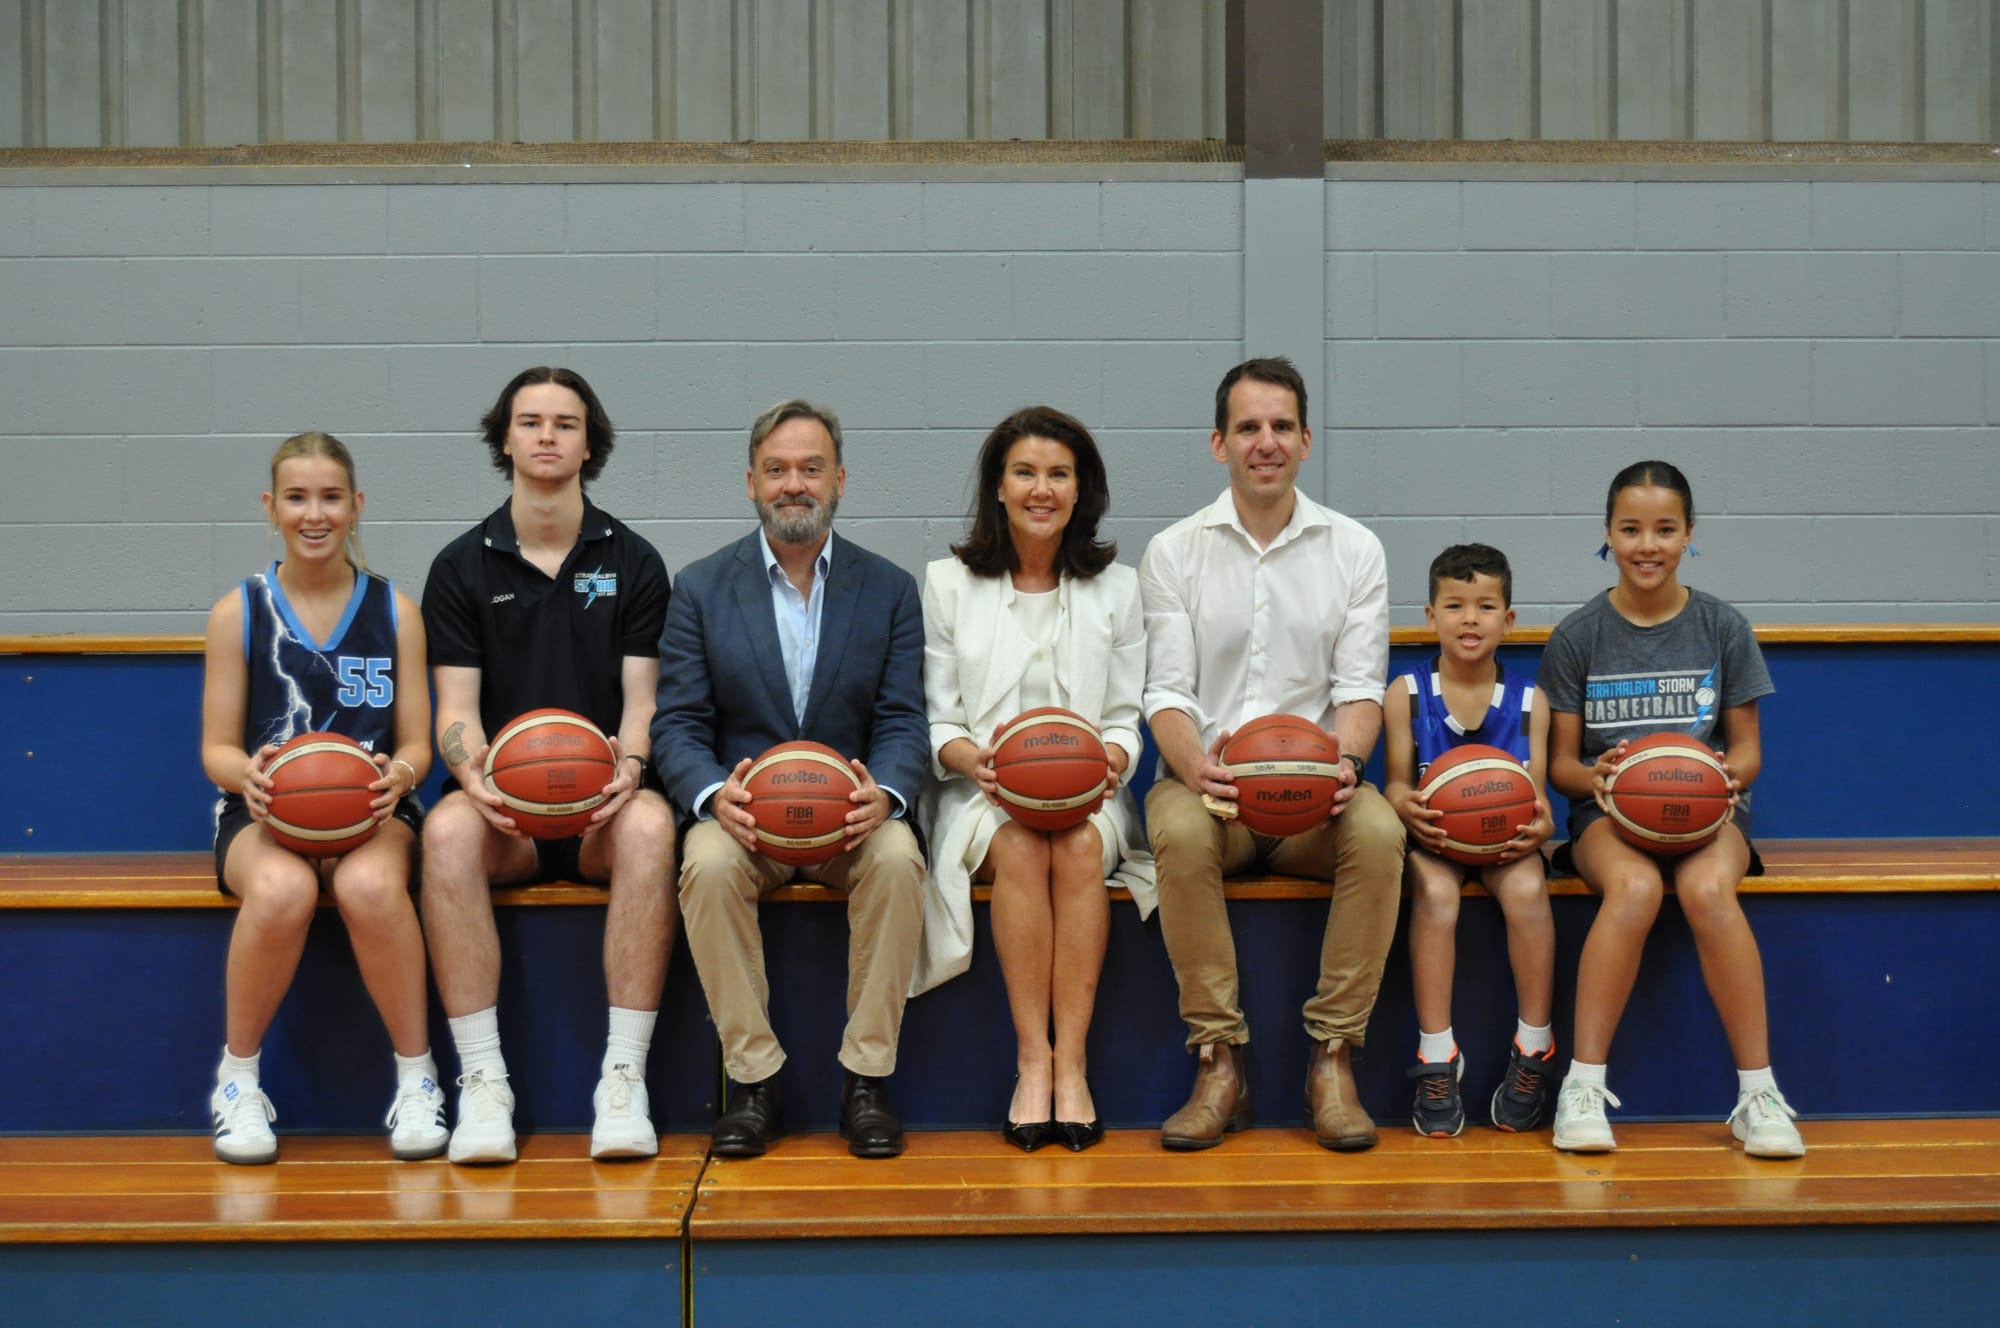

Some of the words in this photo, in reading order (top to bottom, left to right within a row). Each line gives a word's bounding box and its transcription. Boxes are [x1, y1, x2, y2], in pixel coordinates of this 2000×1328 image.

[337, 656, 393, 707] 55
[1586, 679, 1656, 698] STRATHALBYN
[1658, 678, 1695, 694] STORM
[1585, 695, 1695, 721] BASKETBALL
[1023, 733, 1080, 749] molten
[771, 770, 828, 785] molten
[1648, 768, 1704, 783] molten
[1256, 789, 1312, 801] molten
[1461, 780, 1515, 798] molten
[786, 806, 813, 819] FIBA
[1662, 803, 1690, 817] FIBA
[1481, 815, 1507, 829] FIBA
